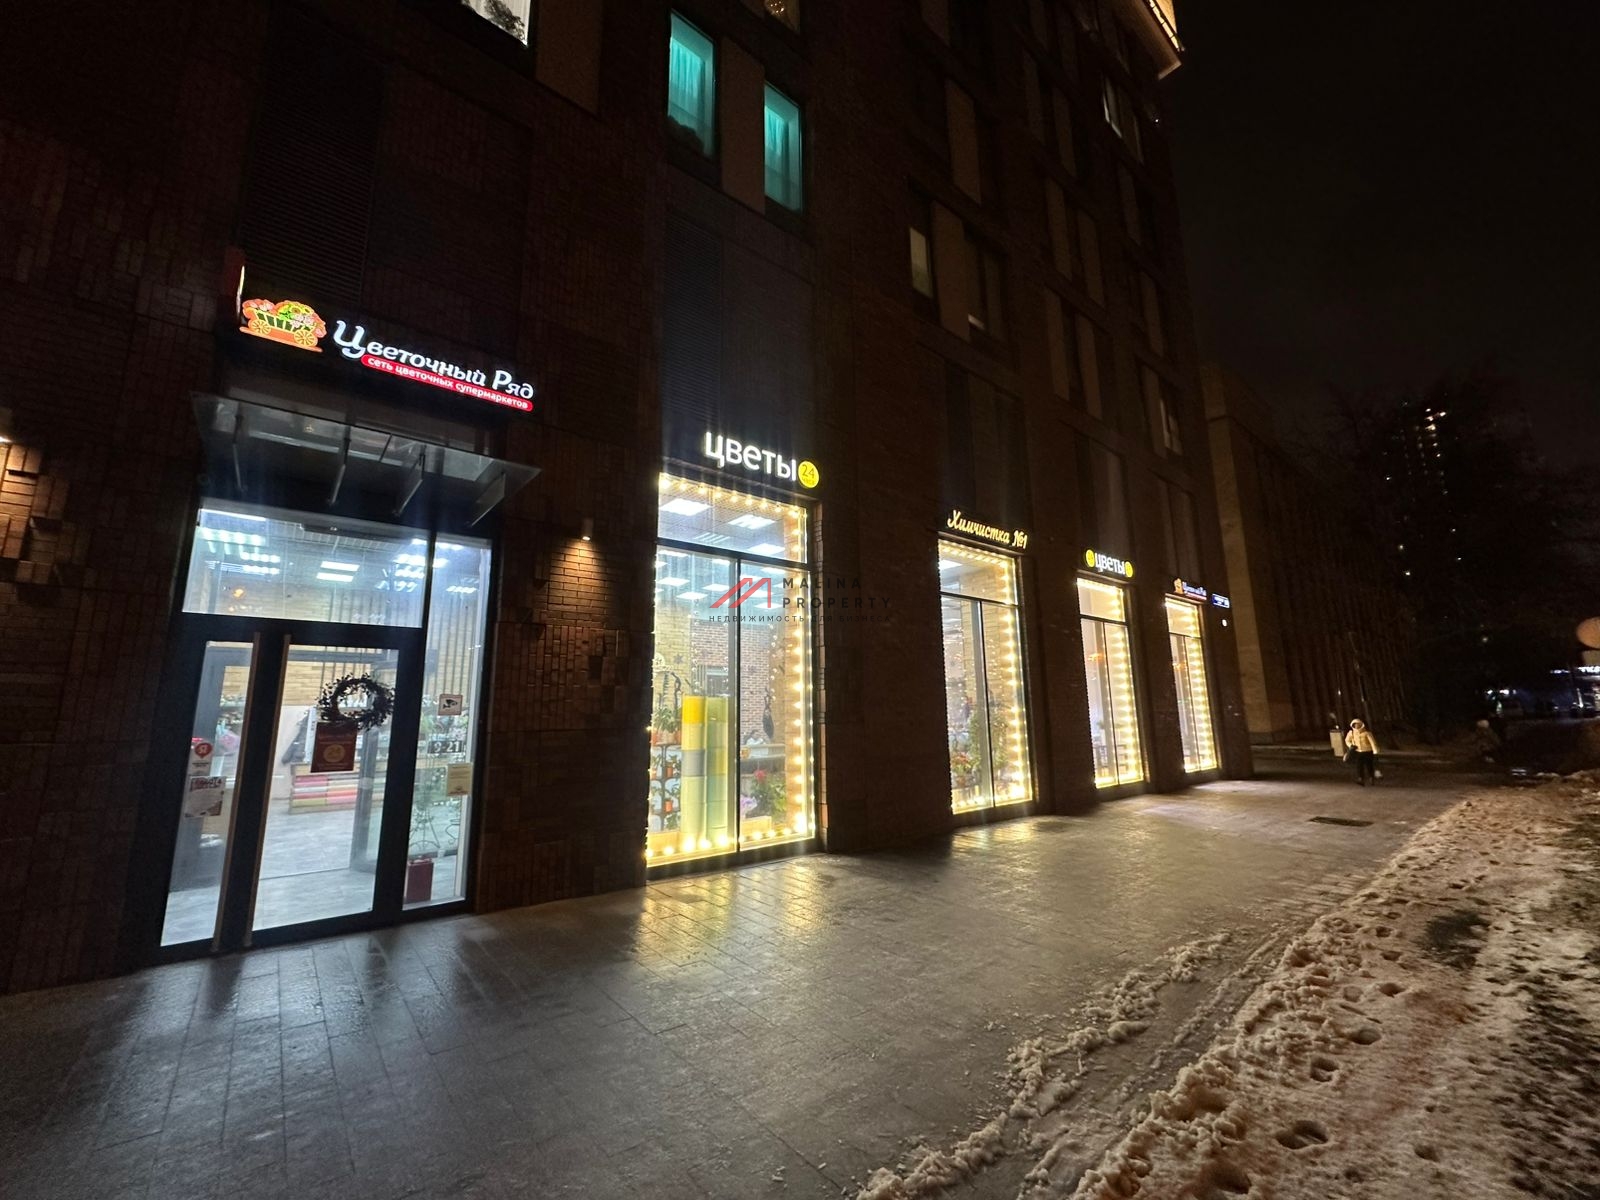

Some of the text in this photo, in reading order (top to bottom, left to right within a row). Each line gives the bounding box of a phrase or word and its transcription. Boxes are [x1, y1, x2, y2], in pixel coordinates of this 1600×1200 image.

[333, 320, 534, 400] Цветочный Ряд
[367, 357, 528, 409] сеть цветочных супермаркетов
[801, 463, 815, 479] 24
[947, 509, 1028, 549] Химчистка №1
